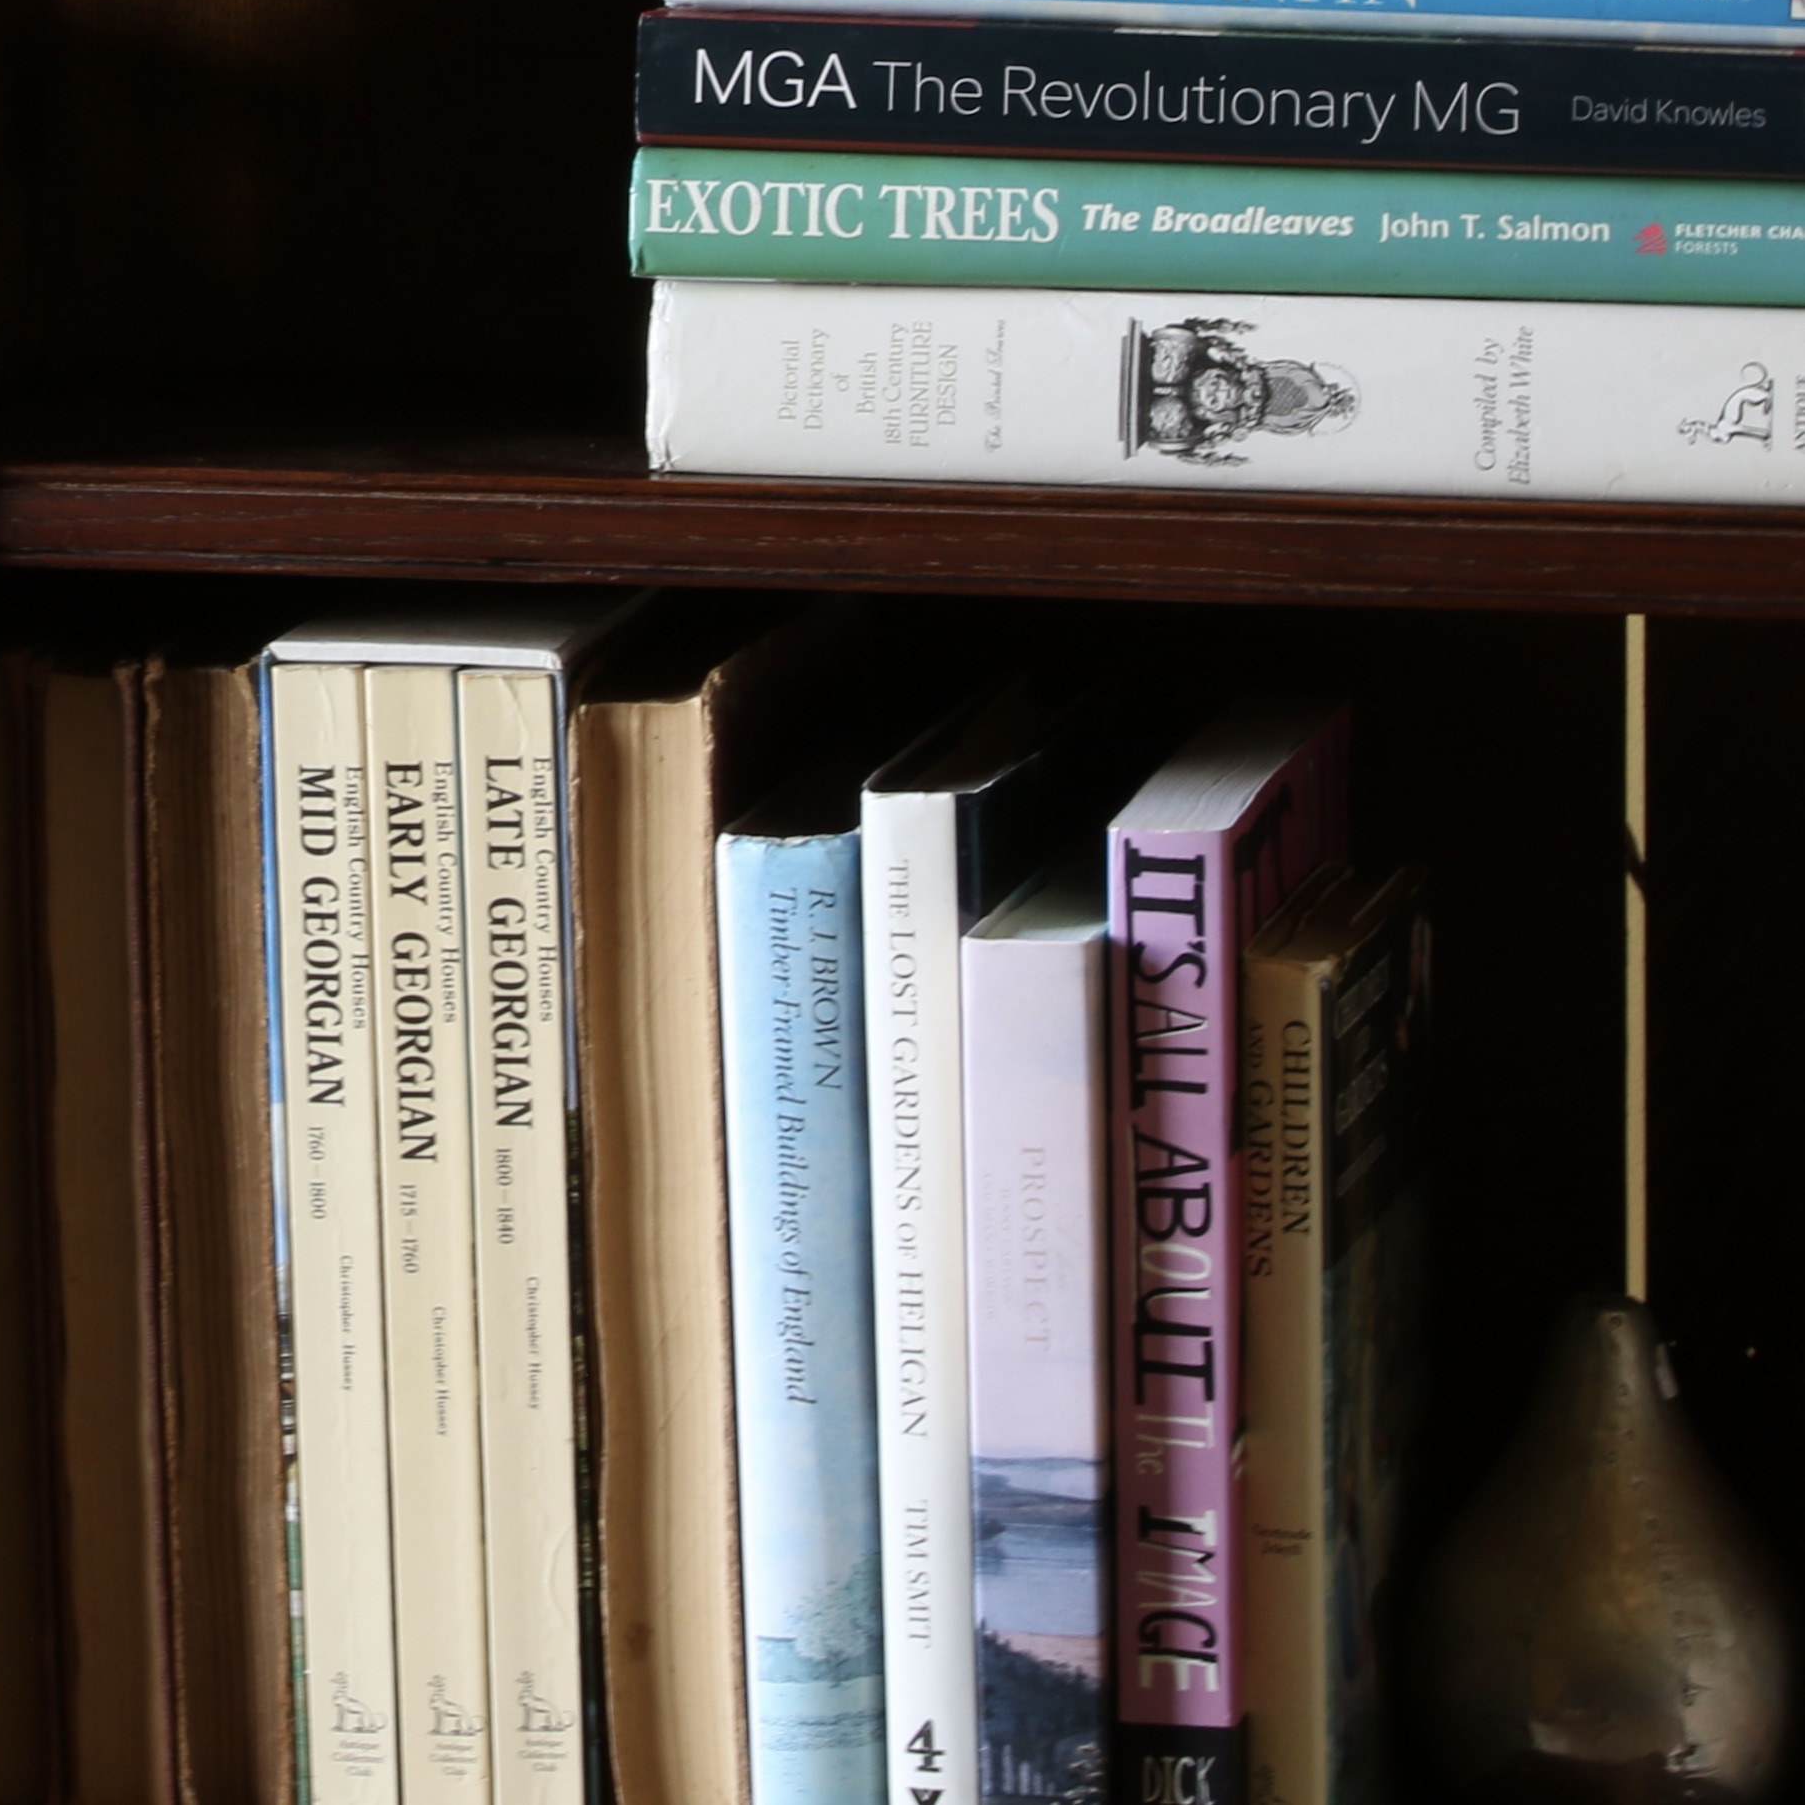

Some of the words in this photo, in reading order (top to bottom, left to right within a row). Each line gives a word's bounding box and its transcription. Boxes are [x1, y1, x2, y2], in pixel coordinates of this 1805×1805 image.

[694, 47, 858, 110] MGA
[872, 60, 983, 116] The
[1002, 64, 1397, 145] Revolutionary
[1413, 79, 1521, 136] MG
[1571, 95, 1648, 125] David
[1655, 98, 1767, 129] Knowles
[644, 178, 864, 240] EXOTIC
[879, 184, 1060, 244] TREES
[1081, 204, 1140, 232] The
[1151, 205, 1355, 237] Broadleaves
[1378, 212, 1451, 243] John
[1459, 213, 1487, 240] T.
[1497, 214, 1611, 244] Salmon
[1674, 222, 1762, 240] FLETCHER
[1674, 239, 1739, 256] FORESTS
[776, 339, 801, 421] Pictorial
[803, 327, 831, 431] Dictionary
[834, 371, 851, 393] of
[854, 350, 877, 415] British
[882, 322, 911, 400] Century
[908, 321, 934, 449] FURNITURE
[935, 342, 959, 427] DESIGN
[1509, 326, 1535, 395] White
[883, 405, 901, 446] 18th
[1474, 375, 1501, 472] Compiled
[1507, 397, 1533, 486] Elizabeth
[297, 764, 340, 857] MID
[345, 765, 365, 849] English
[384, 759, 431, 908] EARLY
[434, 759, 454, 842] English
[484, 754, 528, 872] LATE
[532, 756, 553, 839] English
[346, 856, 370, 943] Country
[435, 851, 459, 937] Country
[533, 848, 556, 935] Country
[808, 888, 836, 919] R.
[888, 858, 910, 918] THE
[300, 875, 346, 1107] GEORGIAN
[349, 952, 369, 1030] Houses
[439, 947, 458, 1025] Houses
[487, 896, 534, 1130] GEORGIAN
[537, 944, 557, 1023] Houses
[769, 886, 807, 1106] Timber-Framed
[889, 929, 919, 1029] LOST
[390, 930, 439, 1164] GEORGIAN
[811, 955, 843, 1090] BROWN
[1132, 996, 1209, 1112] ALL
[1248, 1023, 1265, 1071] AND
[308, 1125, 327, 1161] 1760
[892, 1036, 923, 1214] GARDENS
[1282, 1020, 1312, 1236] CHILDREN
[309, 1180, 328, 1221] 1800
[399, 1183, 418, 1218] 1715
[496, 1147, 513, 1188] 1800
[774, 1112, 810, 1245] Buildings
[1250, 1080, 1275, 1278] GARDENS
[401, 1238, 419, 1276] 1760
[496, 1206, 515, 1246] 1840
[778, 1250, 812, 1284] of
[896, 1221, 919, 1261] OF
[1021, 1145, 1050, 1351] PROSPECT
[1133, 1122, 1216, 1406] ABOUT
[338, 1254, 356, 1335] Christopher
[524, 1275, 541, 1357] Christopher
[342, 1343, 356, 1394] Hussey
[430, 1305, 449, 1383] Christopher
[779, 1285, 817, 1405] England
[896, 1270, 929, 1439] HELIGAN
[434, 1385, 449, 1437] Hussey
[527, 1362, 542, 1411] Hussey
[904, 1499, 931, 1561] TIM
[906, 1570, 932, 1650] SMIT
[1135, 1504, 1220, 1692] IMAGE
[905, 1717, 946, 1774] 4
[1142, 1756, 1217, 1805] DICK
